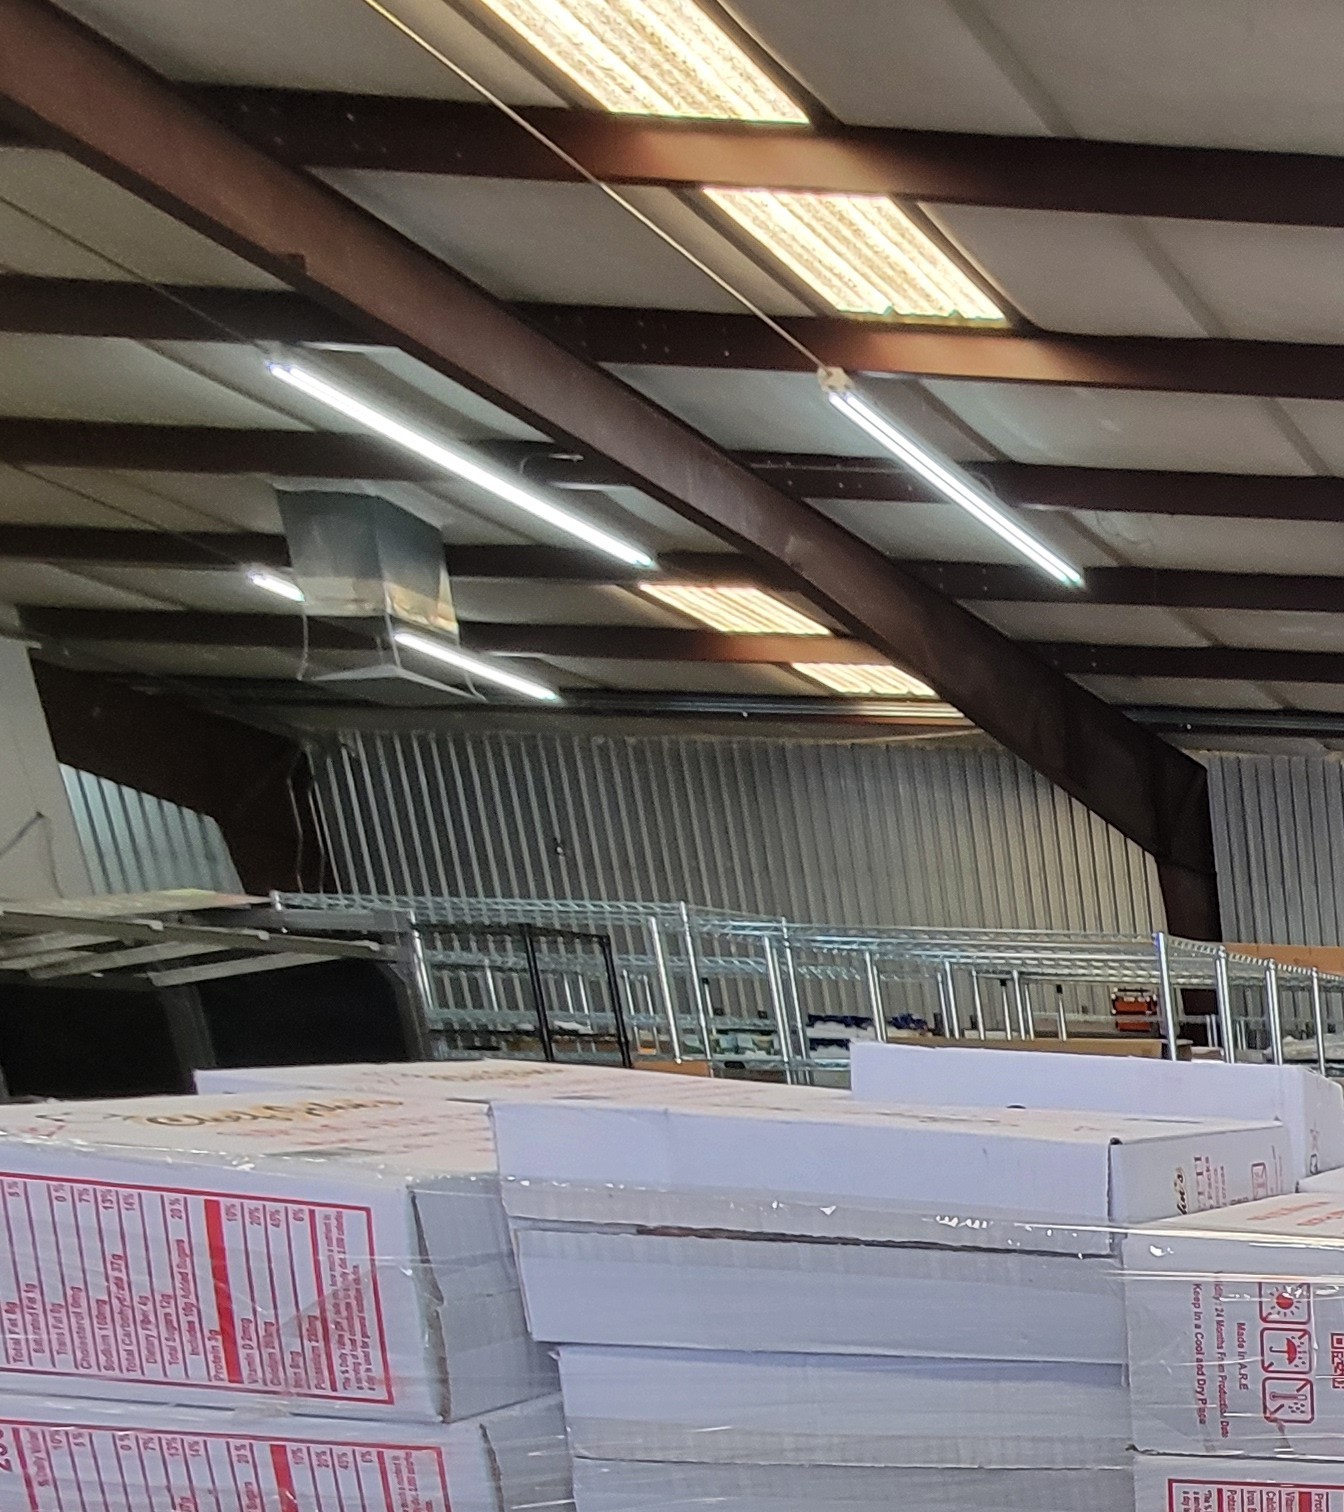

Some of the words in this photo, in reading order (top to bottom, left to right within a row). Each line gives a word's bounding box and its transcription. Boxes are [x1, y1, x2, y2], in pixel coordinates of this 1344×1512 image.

[1194, 1331, 1205, 1356] Cool
[1214, 1319, 1228, 1350] Months
[1236, 1321, 1247, 1349] Made
[1195, 1378, 1206, 1396] Dry
